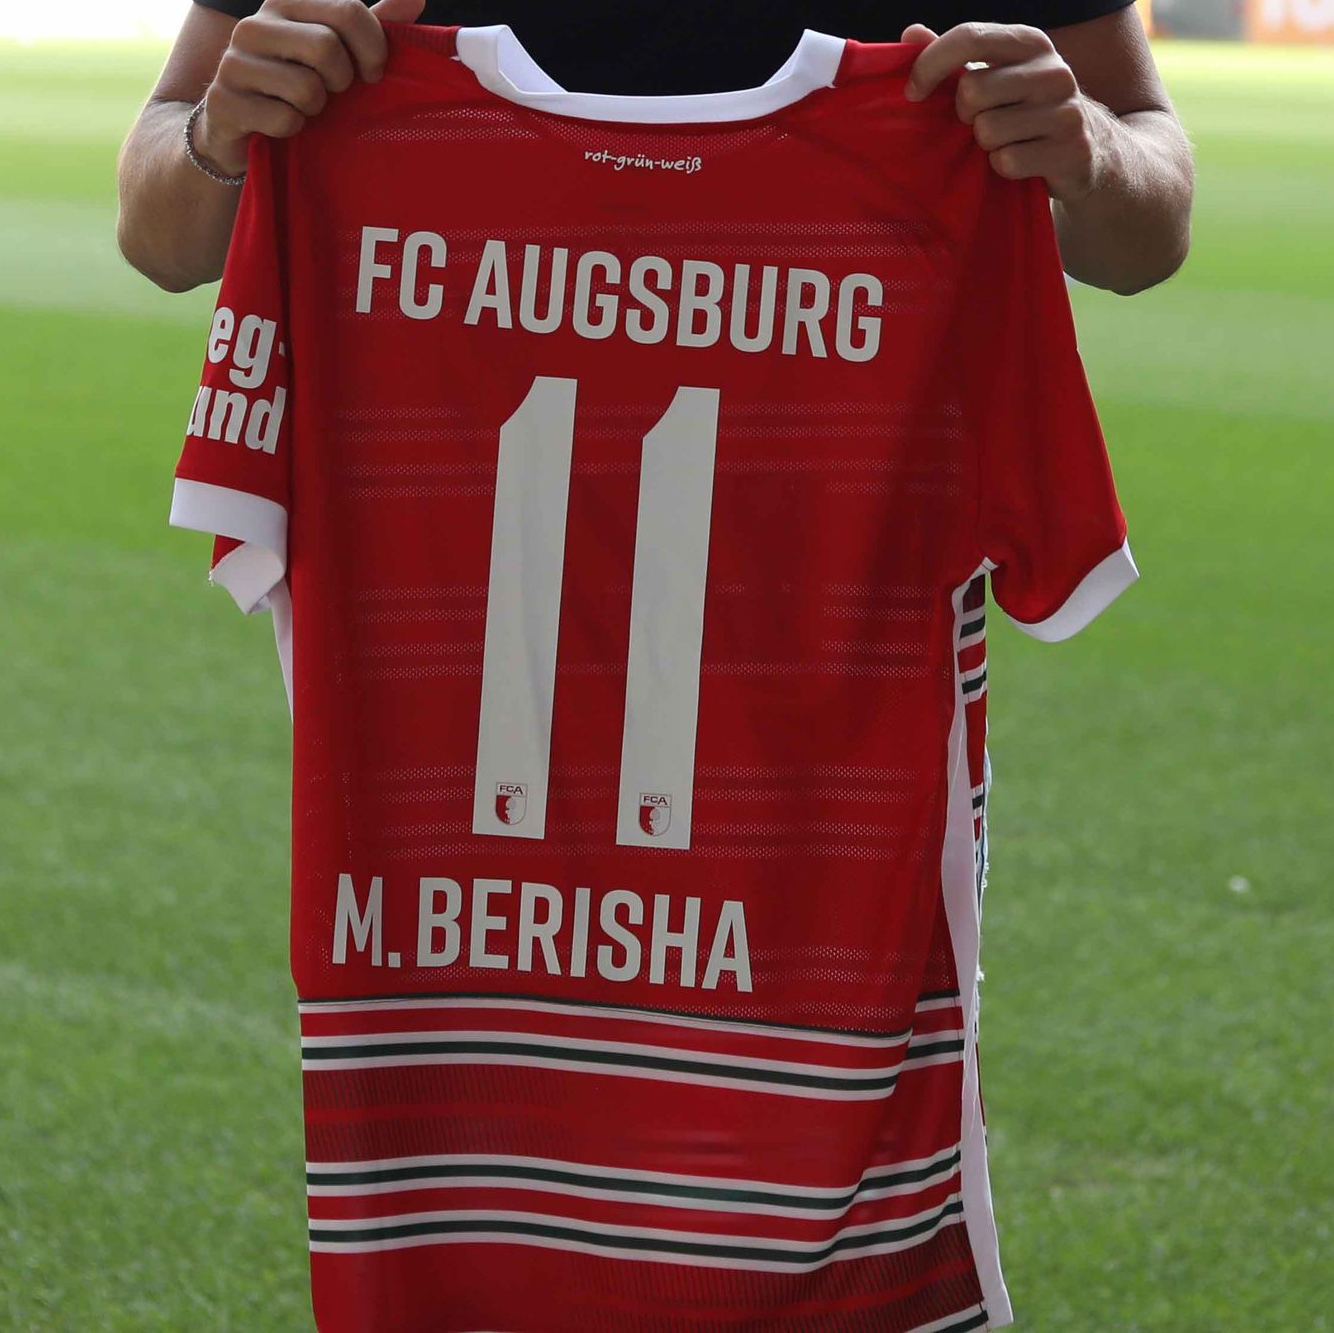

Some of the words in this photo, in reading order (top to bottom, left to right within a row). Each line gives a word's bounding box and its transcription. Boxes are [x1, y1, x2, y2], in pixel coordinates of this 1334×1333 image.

[584, 149, 702, 174] rot-grün-weiß
[355, 226, 447, 320] FC
[463, 239, 884, 363] AUGSBURG
[472, 375, 721, 850] 11
[499, 784, 524, 795] FCA
[642, 795, 668, 806] FCA
